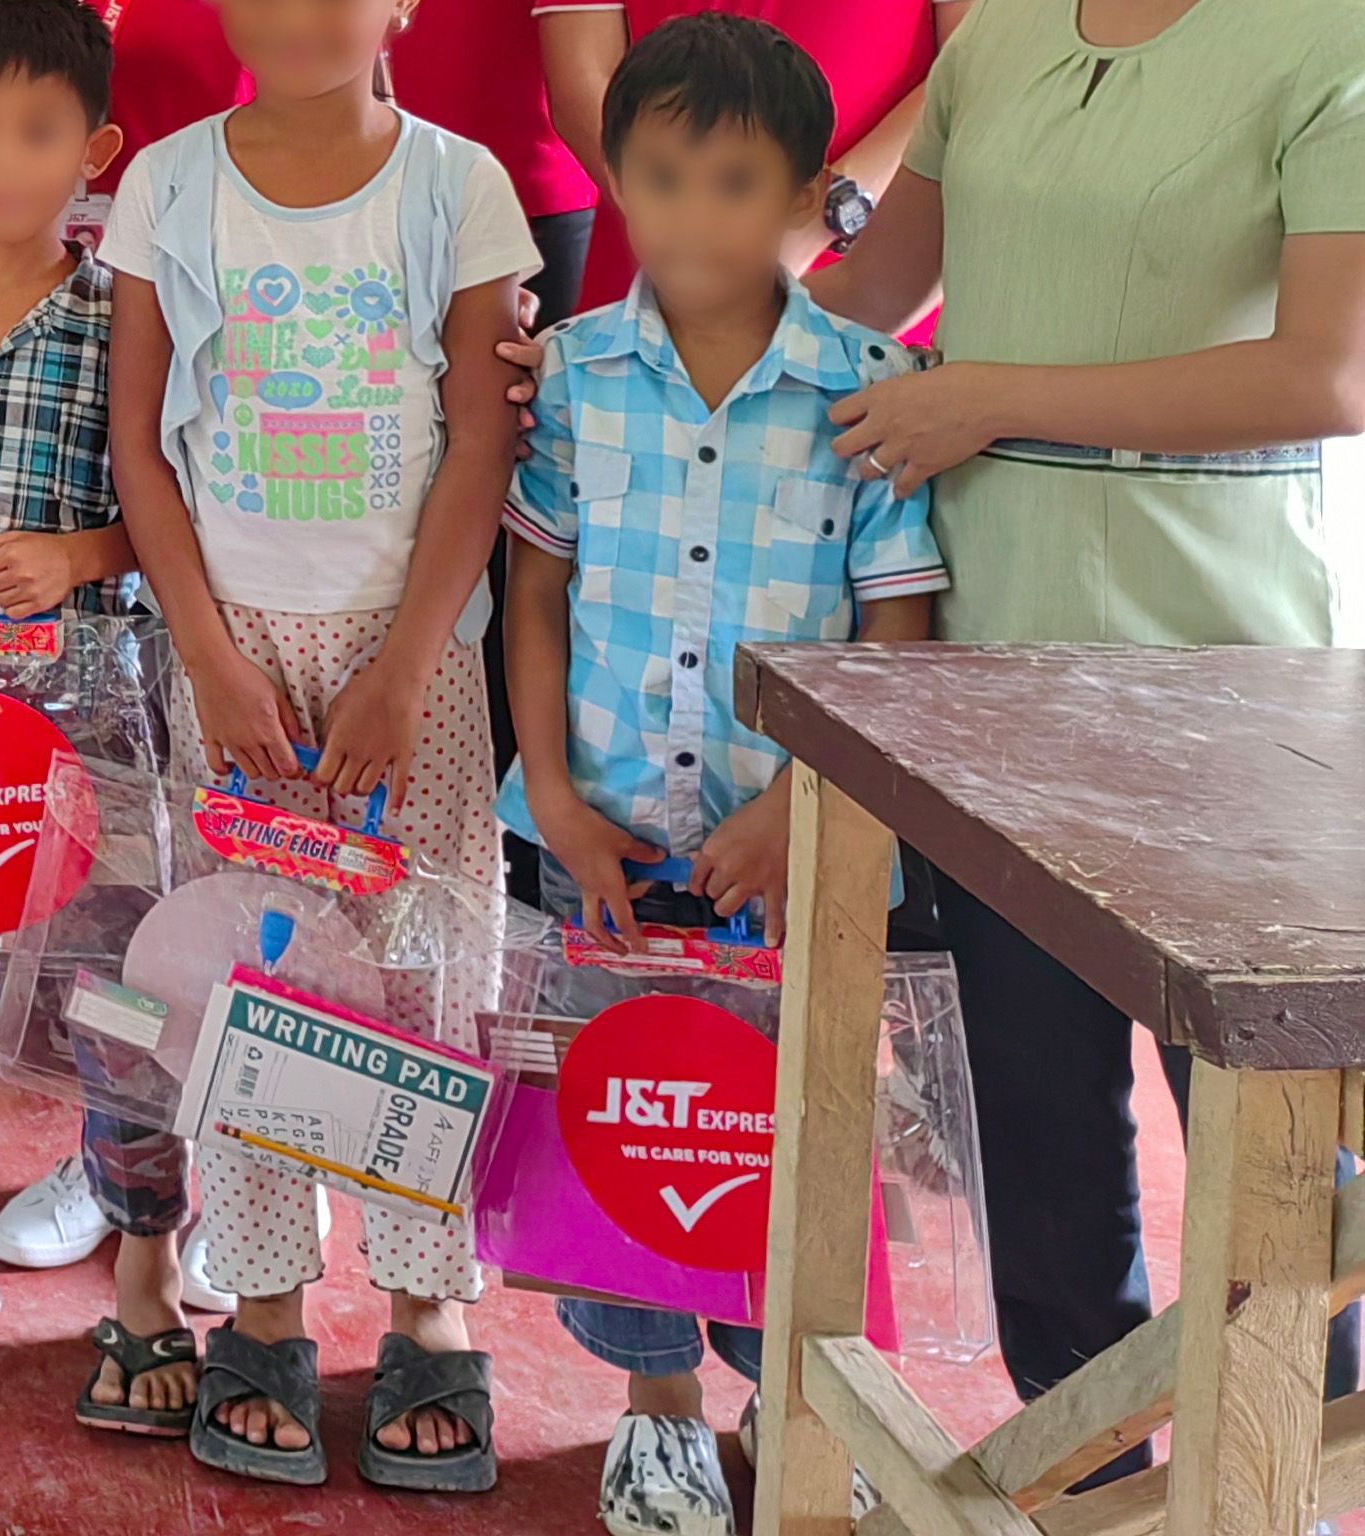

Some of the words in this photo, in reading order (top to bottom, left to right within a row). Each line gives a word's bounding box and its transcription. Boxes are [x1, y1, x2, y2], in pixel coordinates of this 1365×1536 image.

[238, 432, 369, 475] KISSES
[266, 478, 366, 521] HUGS
[13, 820, 43, 834] YOU
[227, 816, 290, 849] FLYING
[288, 834, 340, 863] EAGLE
[247, 1001, 387, 1076] WRITING
[398, 1051, 468, 1103] PAD
[586, 1077, 712, 1128] J&T
[372, 1093, 418, 1174] GRADE
[621, 1144, 647, 1160] WE
[651, 1147, 694, 1162] CARE
[697, 1150, 731, 1165] FOR
[735, 1152, 770, 1167] YOU
